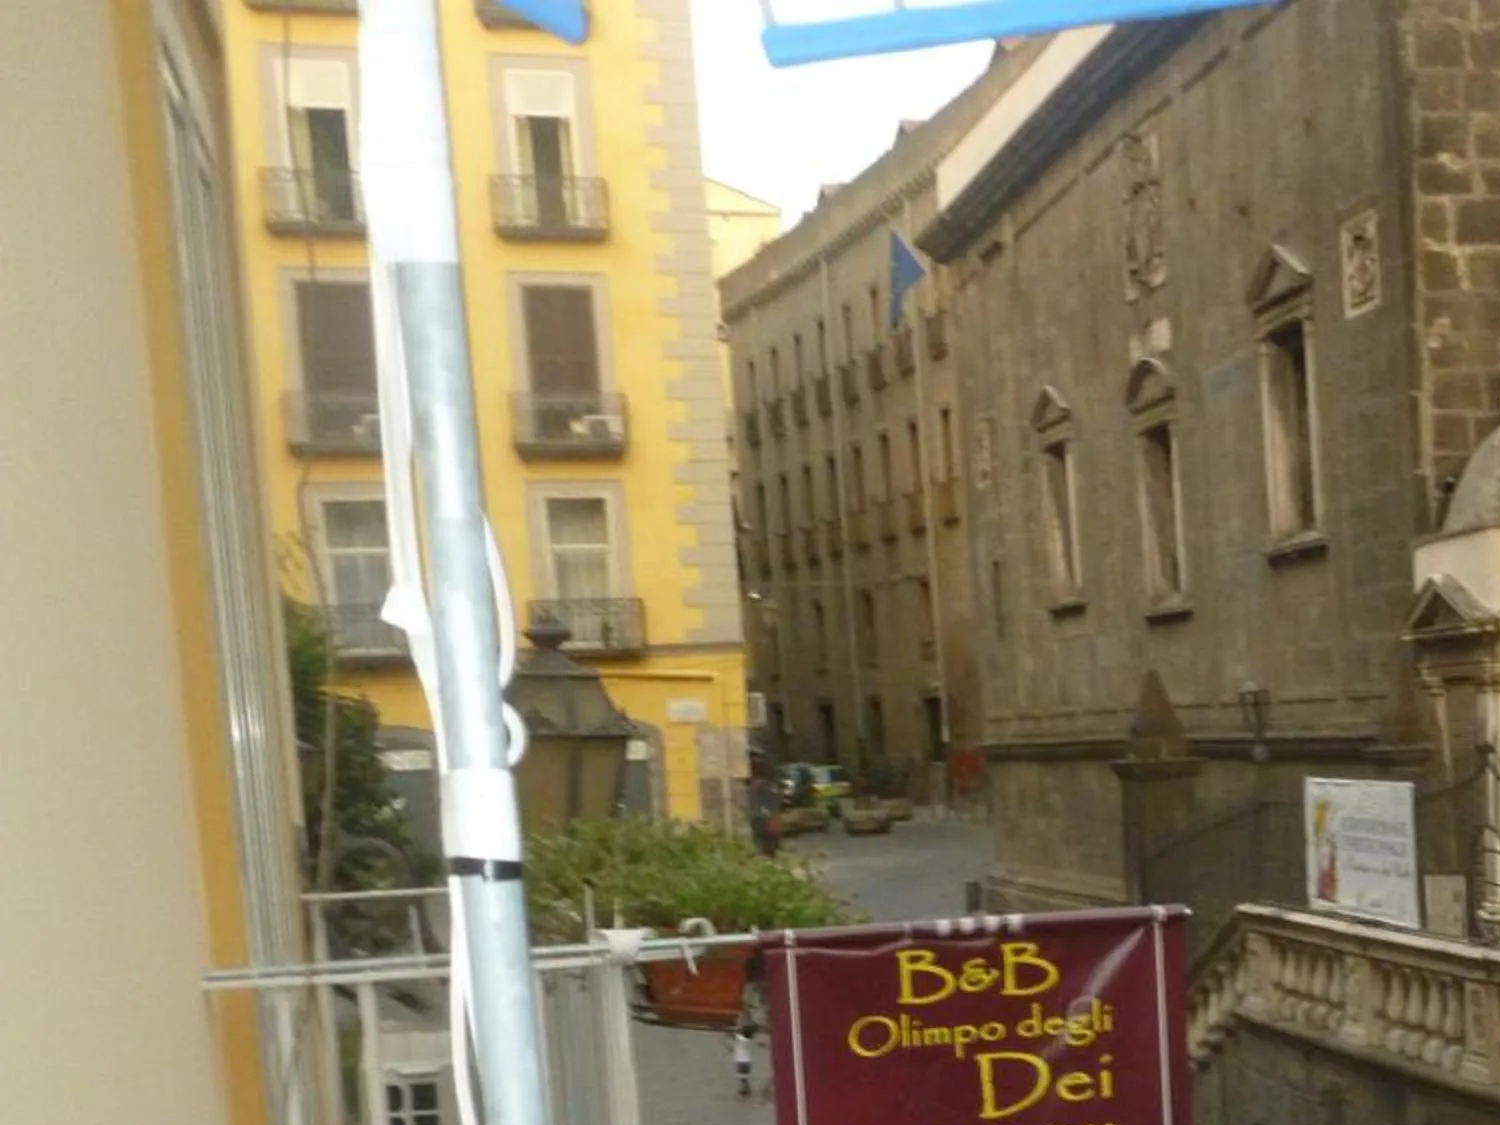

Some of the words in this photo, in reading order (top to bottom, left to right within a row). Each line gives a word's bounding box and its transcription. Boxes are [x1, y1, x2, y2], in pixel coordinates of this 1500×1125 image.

[896, 942, 1060, 1005] B&B
[848, 1013, 1006, 1058] Olimpo
[1016, 997, 1113, 1046] degli
[975, 1050, 1114, 1119] Dei
